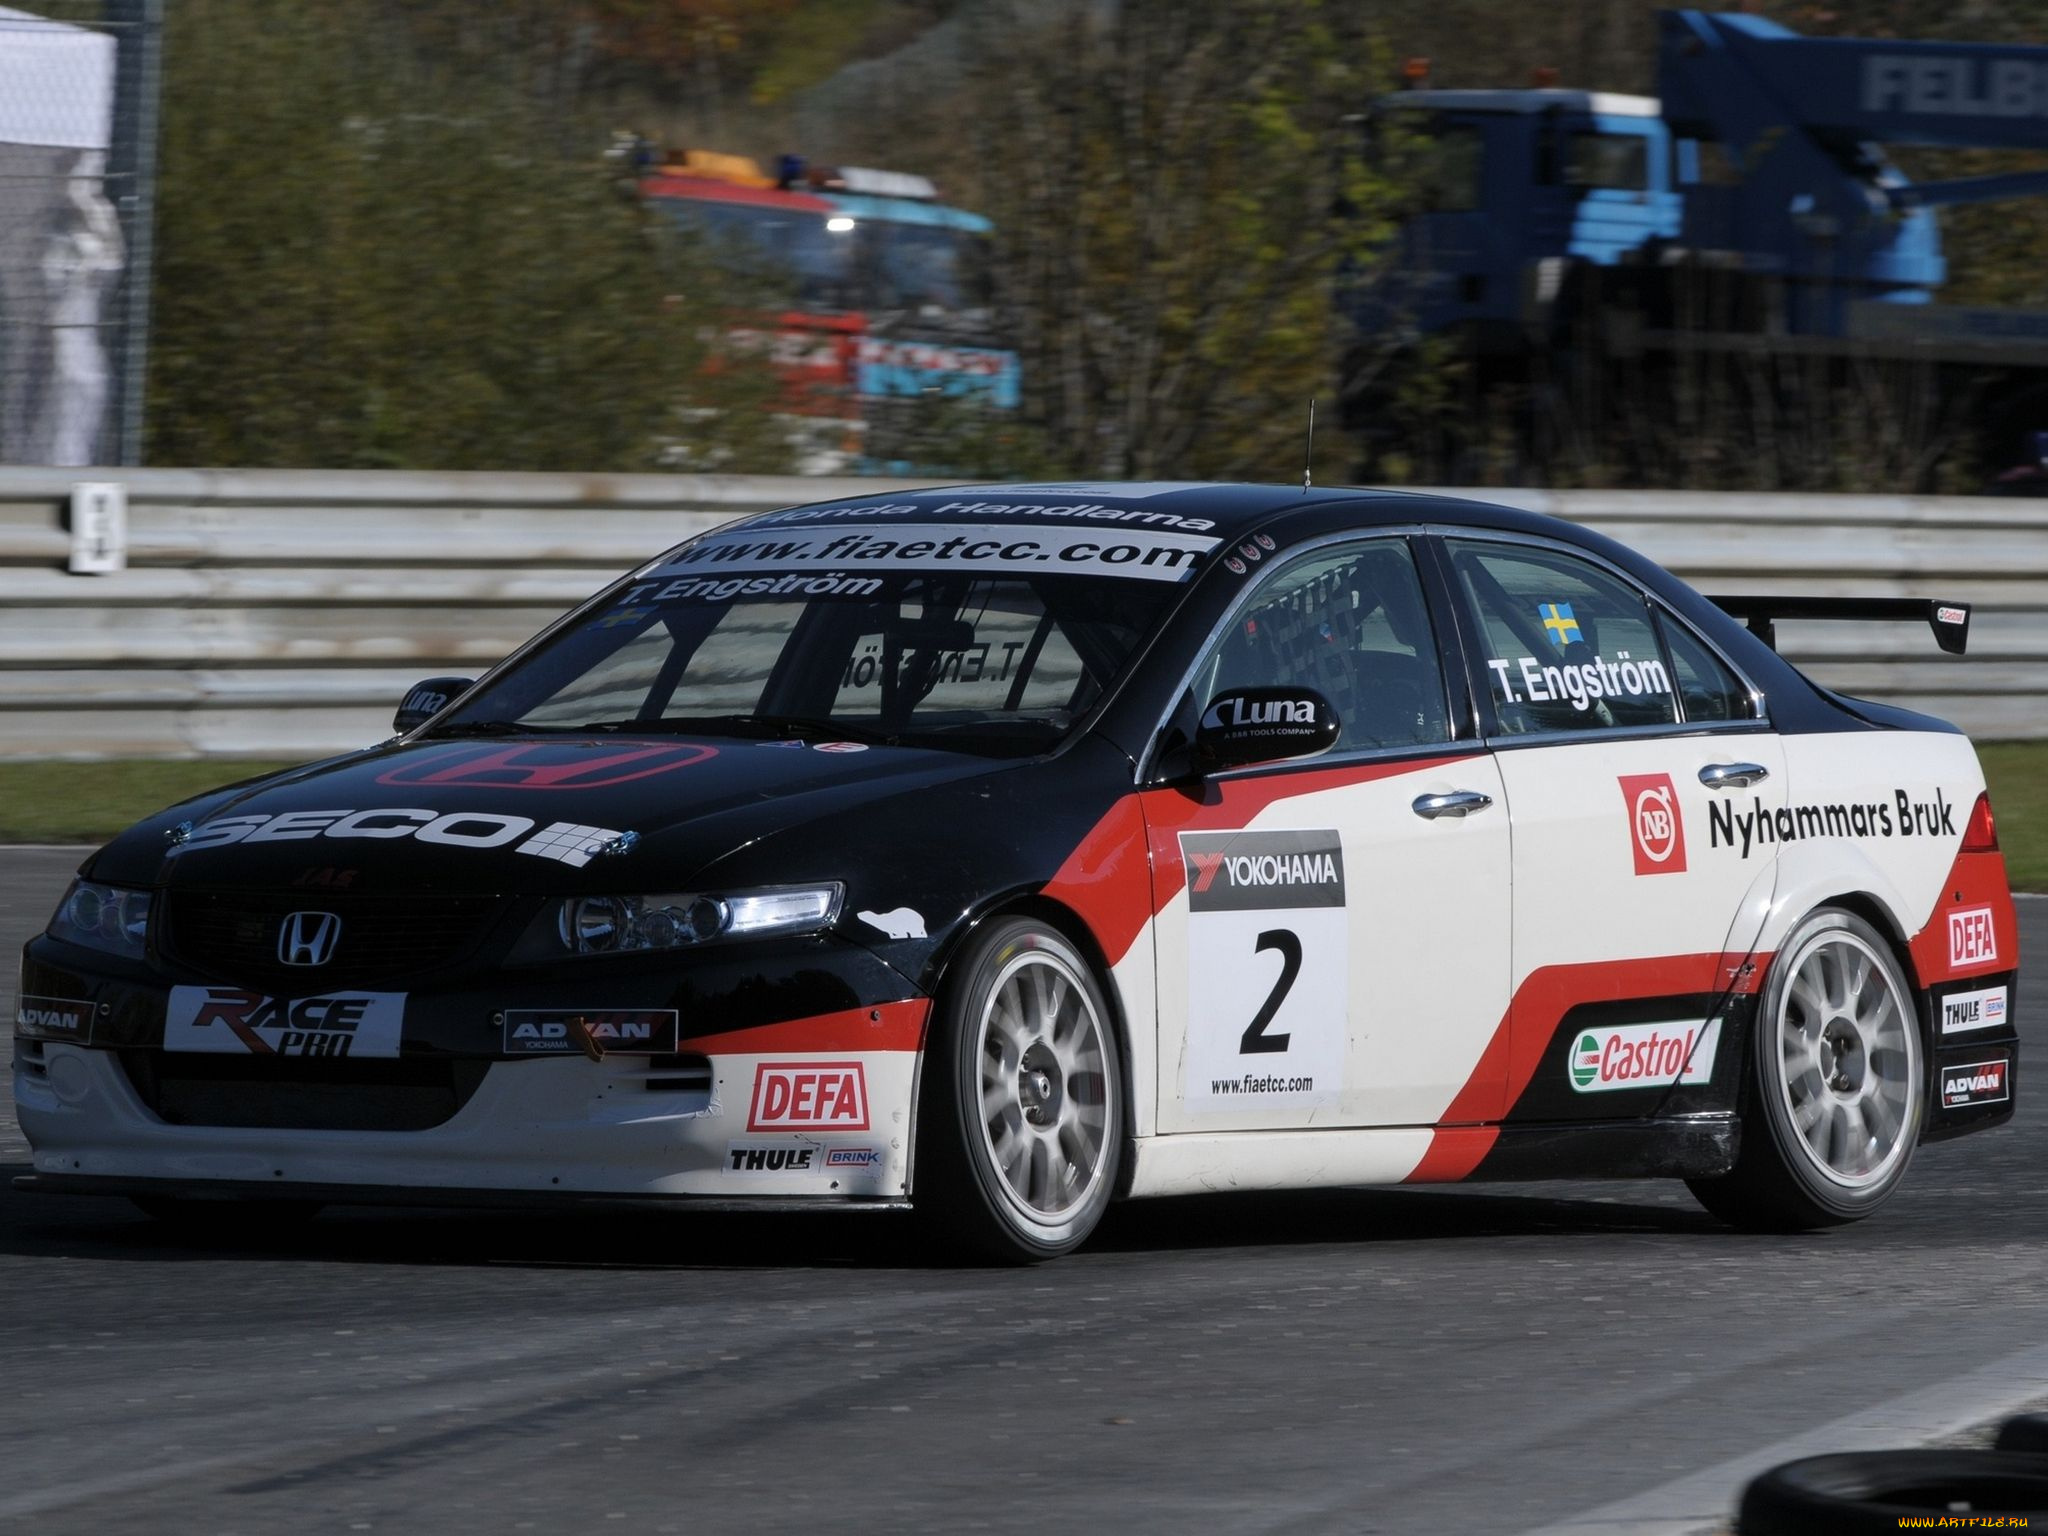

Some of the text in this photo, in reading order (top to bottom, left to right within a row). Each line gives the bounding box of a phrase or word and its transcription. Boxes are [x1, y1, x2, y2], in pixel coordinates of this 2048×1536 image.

[745, 502, 1216, 531] Honda Handlarna
[669, 534, 1208, 568] www.fiaetcc.com
[617, 572, 884, 606] T. Engström
[1488, 651, 1672, 711] T. Engström
[1232, 697, 1316, 725] Luna
[1250, 728, 1276, 737] TOOLS
[1276, 726, 1316, 736] COMPANY
[165, 808, 536, 859] SECO
[1641, 810, 1671, 841] NB
[1708, 787, 1957, 860] Nyhammars Bruk
[1224, 854, 1338, 887] YOKOHAMA
[1953, 914, 1994, 961] DEFA
[1239, 928, 1303, 1055] 2
[17, 1008, 80, 1030] ADVAN
[192, 989, 367, 1056] RACE
[1946, 1001, 1980, 1026] THULE
[525, 1039, 569, 1049] YOKOHAMA
[1601, 1028, 1695, 1082] Castrol
[761, 1073, 858, 1121] DEFA
[1211, 1074, 1314, 1095] www.fiaetcc.com
[1944, 1073, 2000, 1095] ADVAN
[730, 1149, 814, 1171] THULE
[830, 1151, 880, 1164] BRINK
